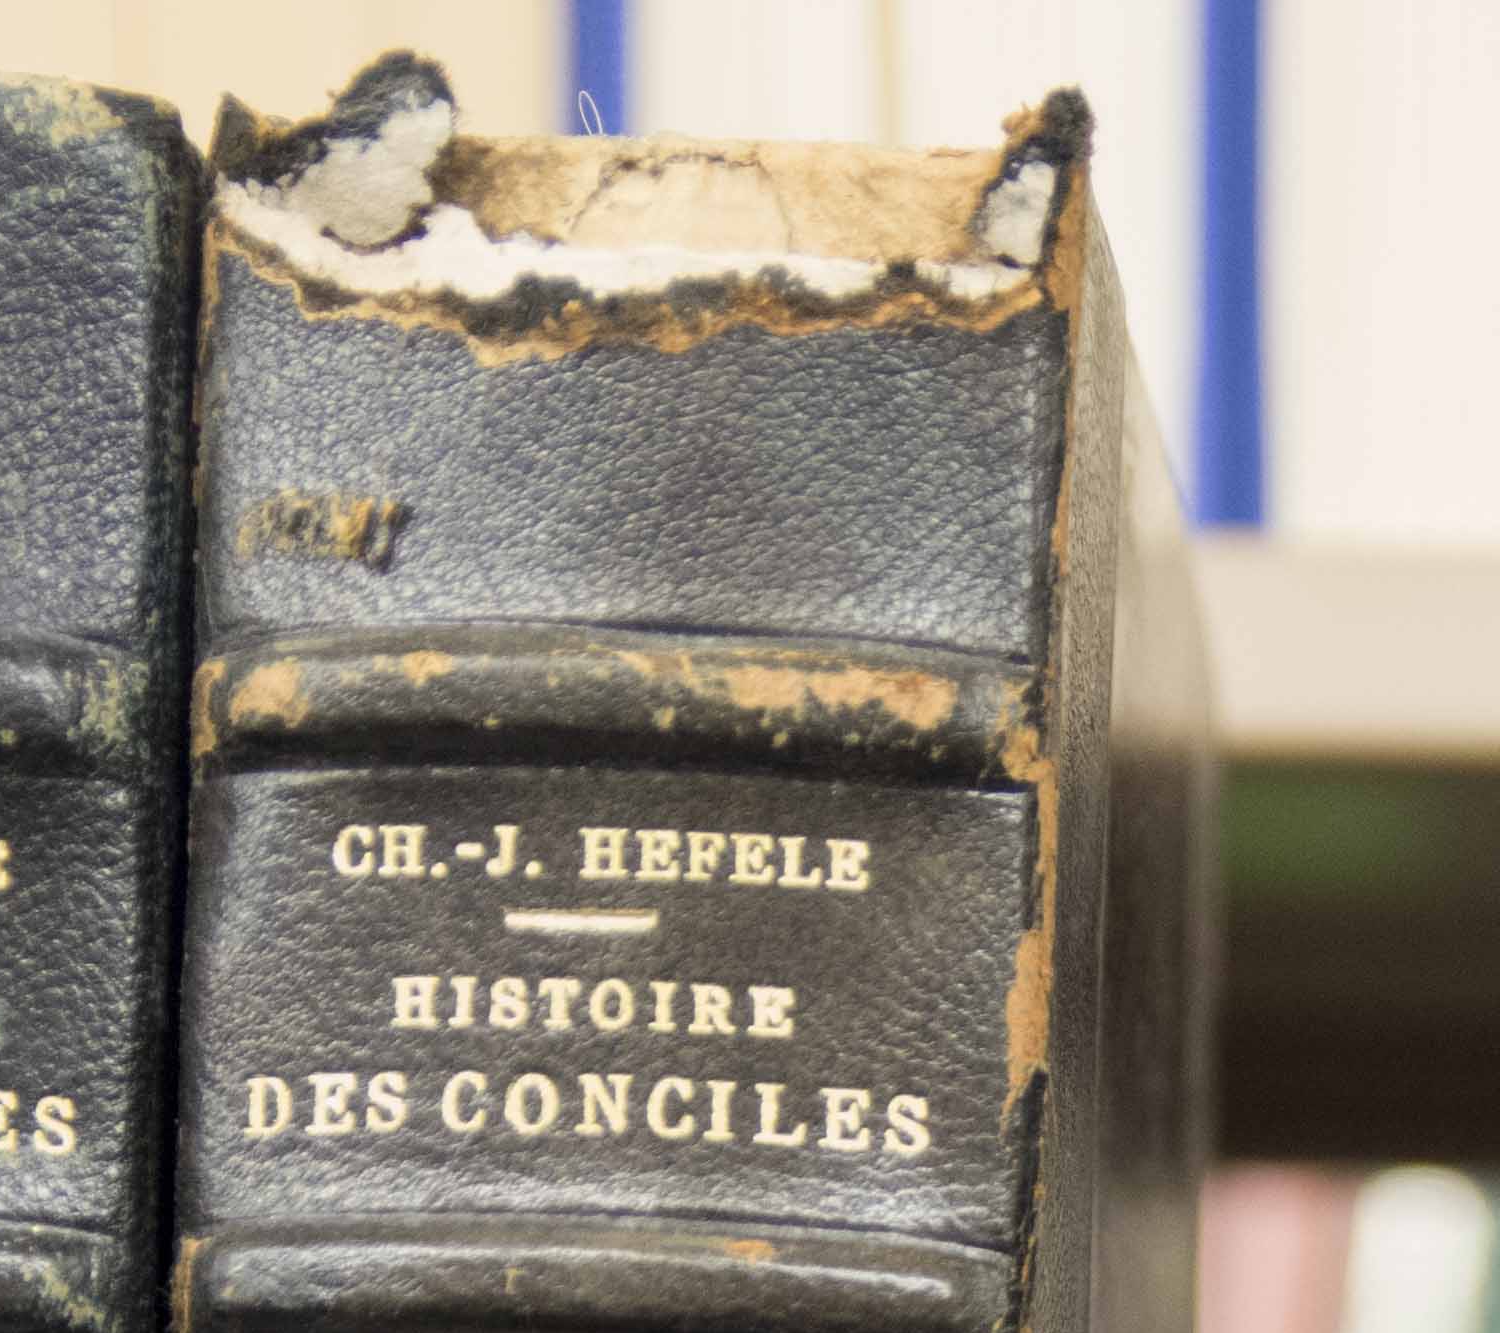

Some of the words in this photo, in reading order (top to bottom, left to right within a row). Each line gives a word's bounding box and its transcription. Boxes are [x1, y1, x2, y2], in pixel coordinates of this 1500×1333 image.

[331, 824, 544, 881] CH.-J.
[578, 826, 872, 892] HEFELE
[391, 975, 797, 1039] HISTOIRE
[243, 1071, 409, 1141] DES
[440, 1073, 932, 1159] CONCILES
